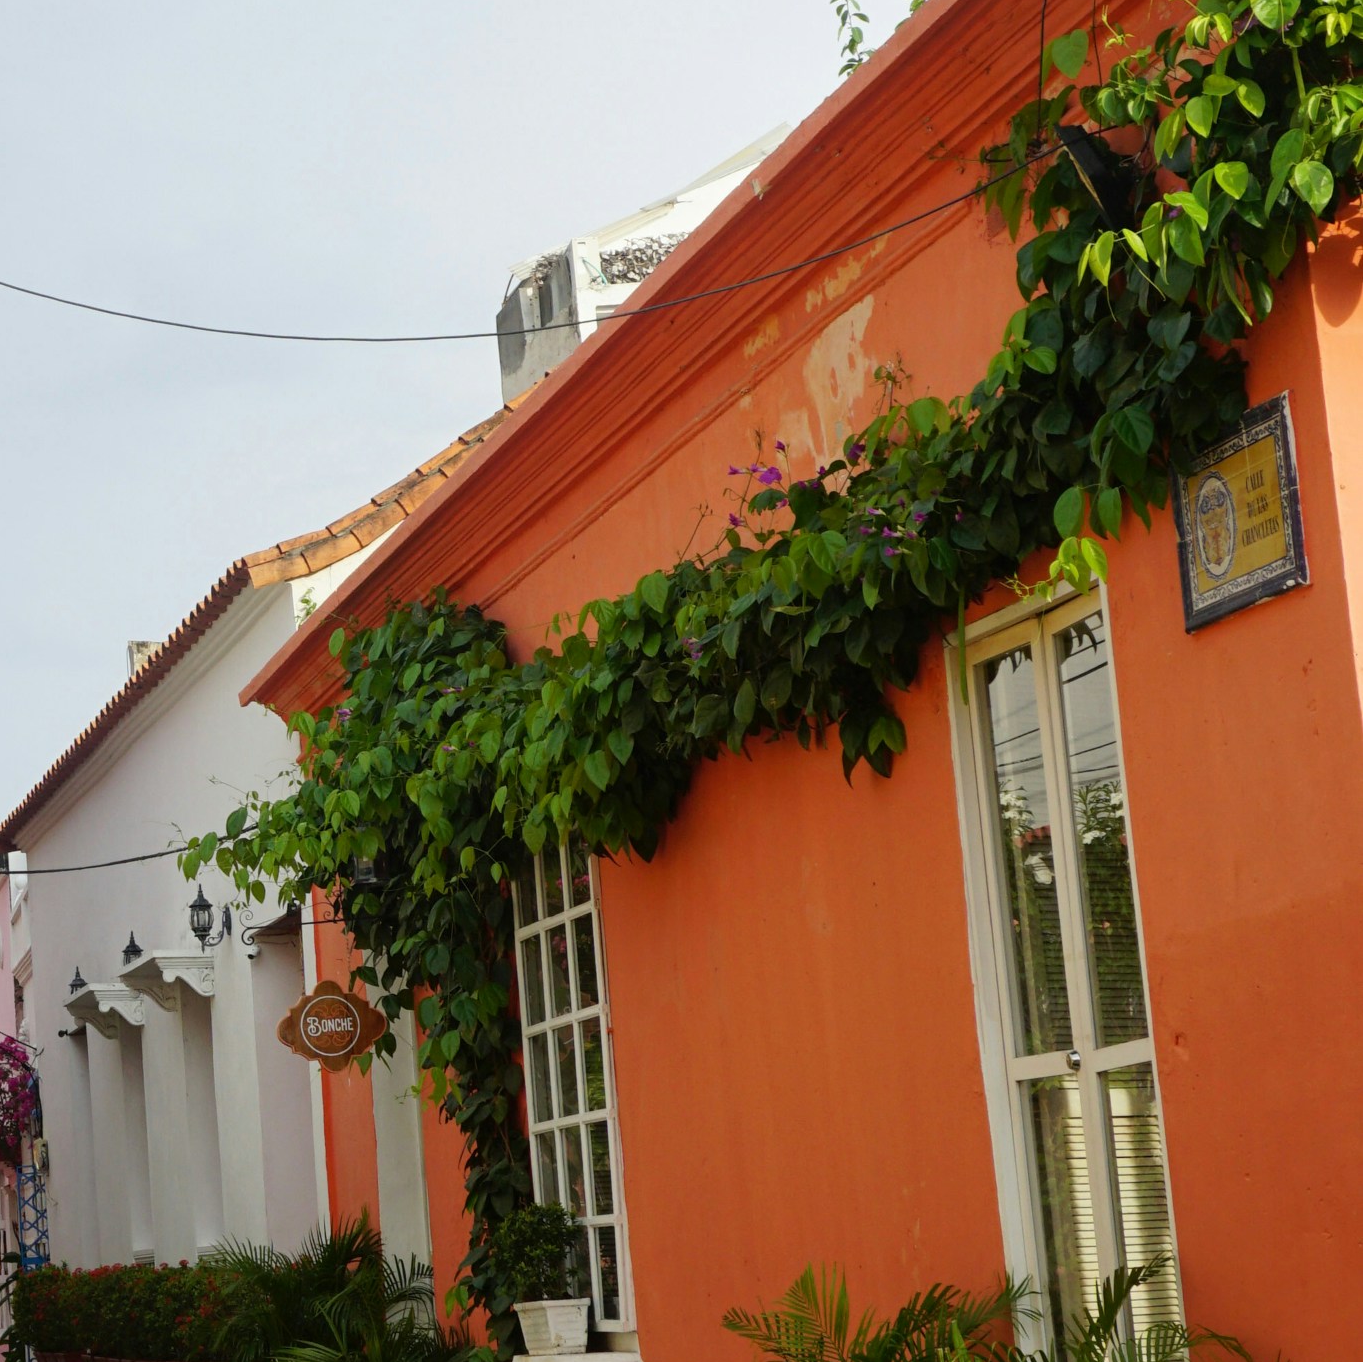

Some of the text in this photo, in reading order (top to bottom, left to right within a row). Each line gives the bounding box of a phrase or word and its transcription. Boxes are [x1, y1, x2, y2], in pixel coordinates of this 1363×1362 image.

[1245, 469, 1265, 494] CALLE
[1247, 493, 1269, 518] DE LAS
[1241, 515, 1280, 547] CHANCLETAS
[306, 1016, 355, 1037] BONCHE
